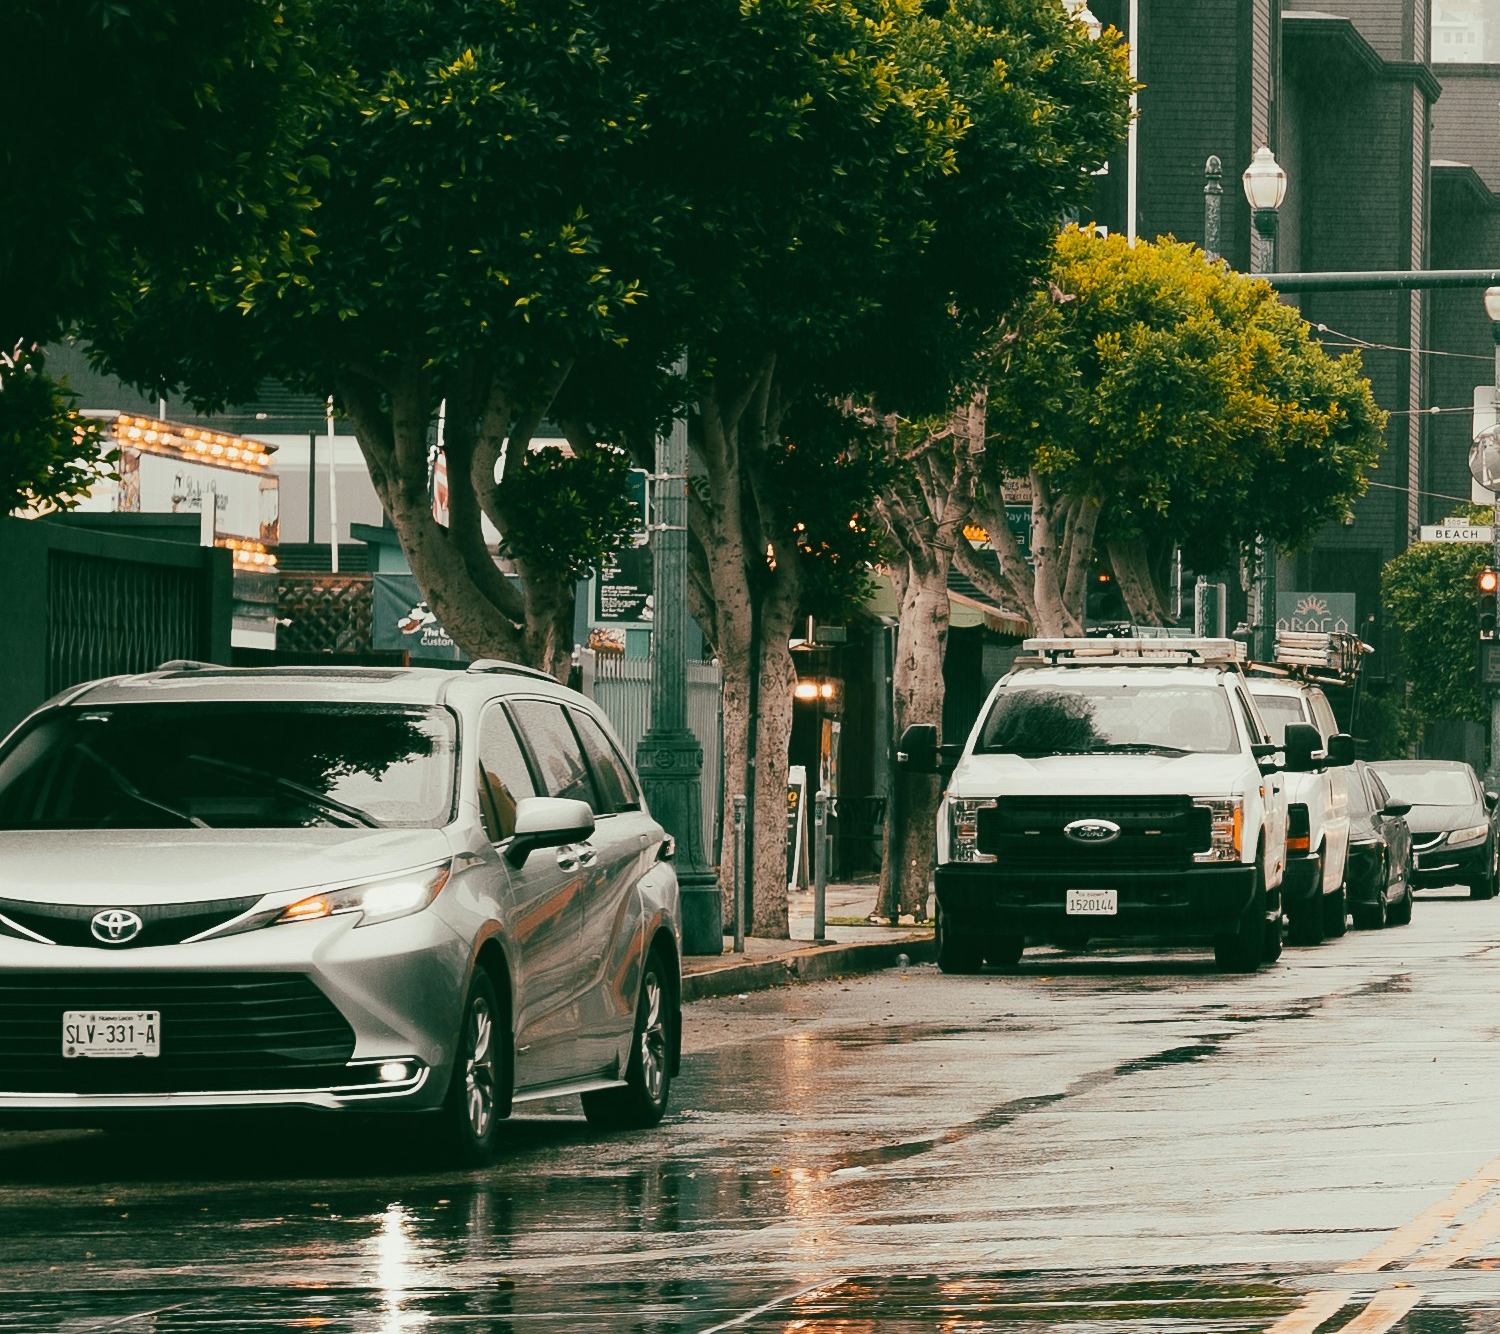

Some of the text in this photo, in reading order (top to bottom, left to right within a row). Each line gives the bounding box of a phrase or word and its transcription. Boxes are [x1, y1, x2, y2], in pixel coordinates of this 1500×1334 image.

[1435, 529, 1478, 539] BEACH
[1070, 899, 1114, 911] 1520144
[66, 1024, 155, 1045] SLV-331-A
